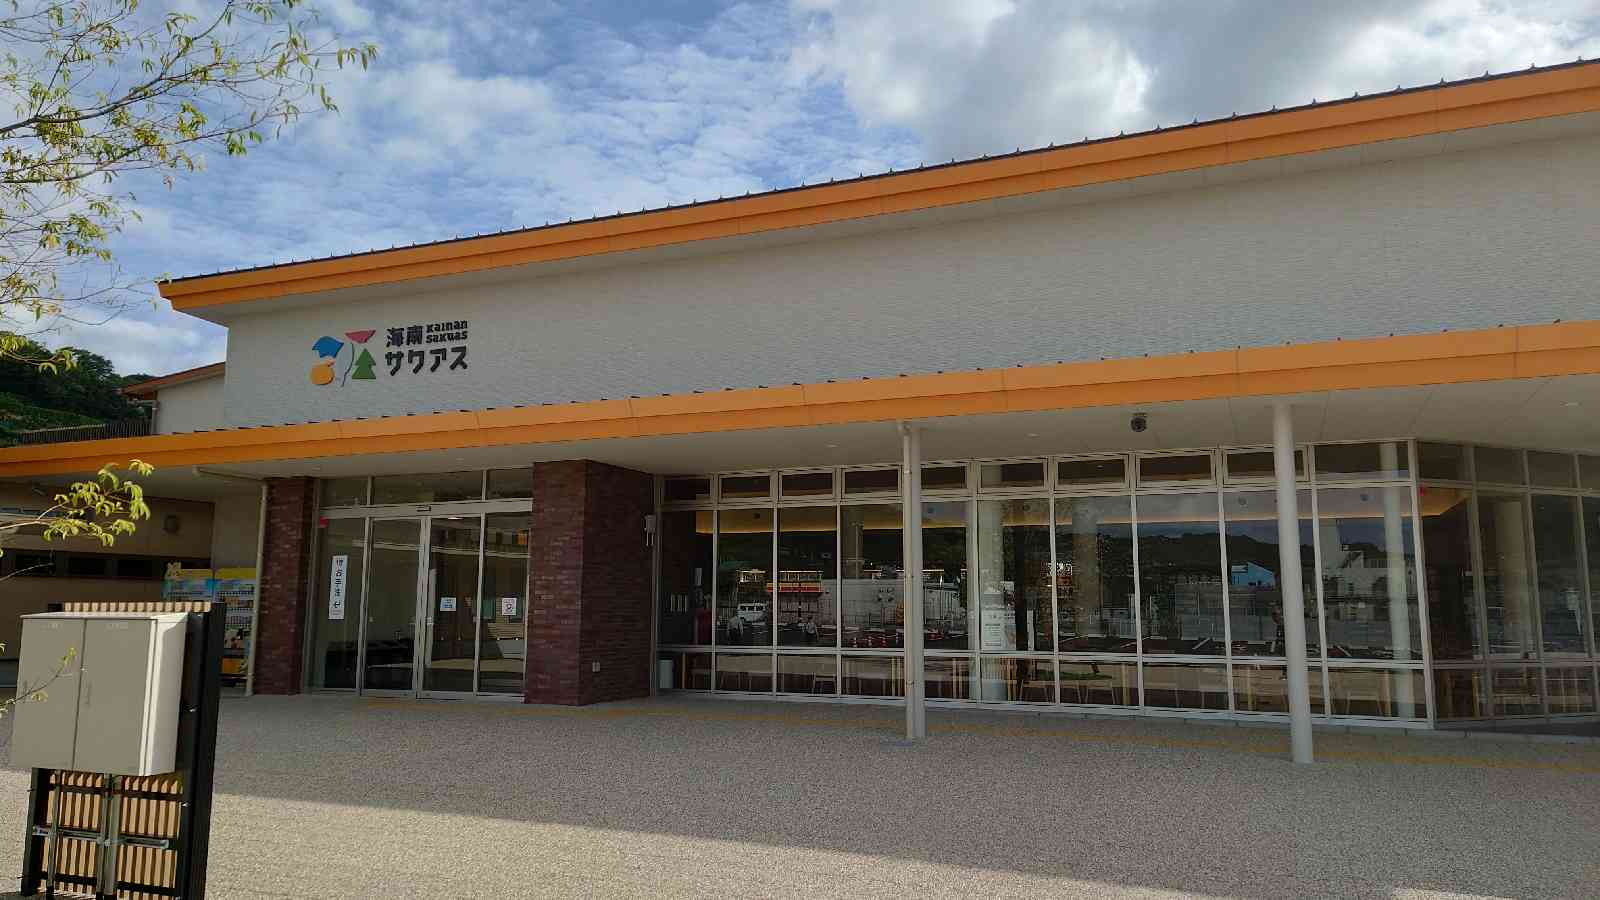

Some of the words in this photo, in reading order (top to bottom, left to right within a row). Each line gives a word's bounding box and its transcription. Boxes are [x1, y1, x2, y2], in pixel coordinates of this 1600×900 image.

[386, 325, 424, 347] 海南
[426, 331, 468, 343] sakuas
[385, 345, 468, 376] サクアス
